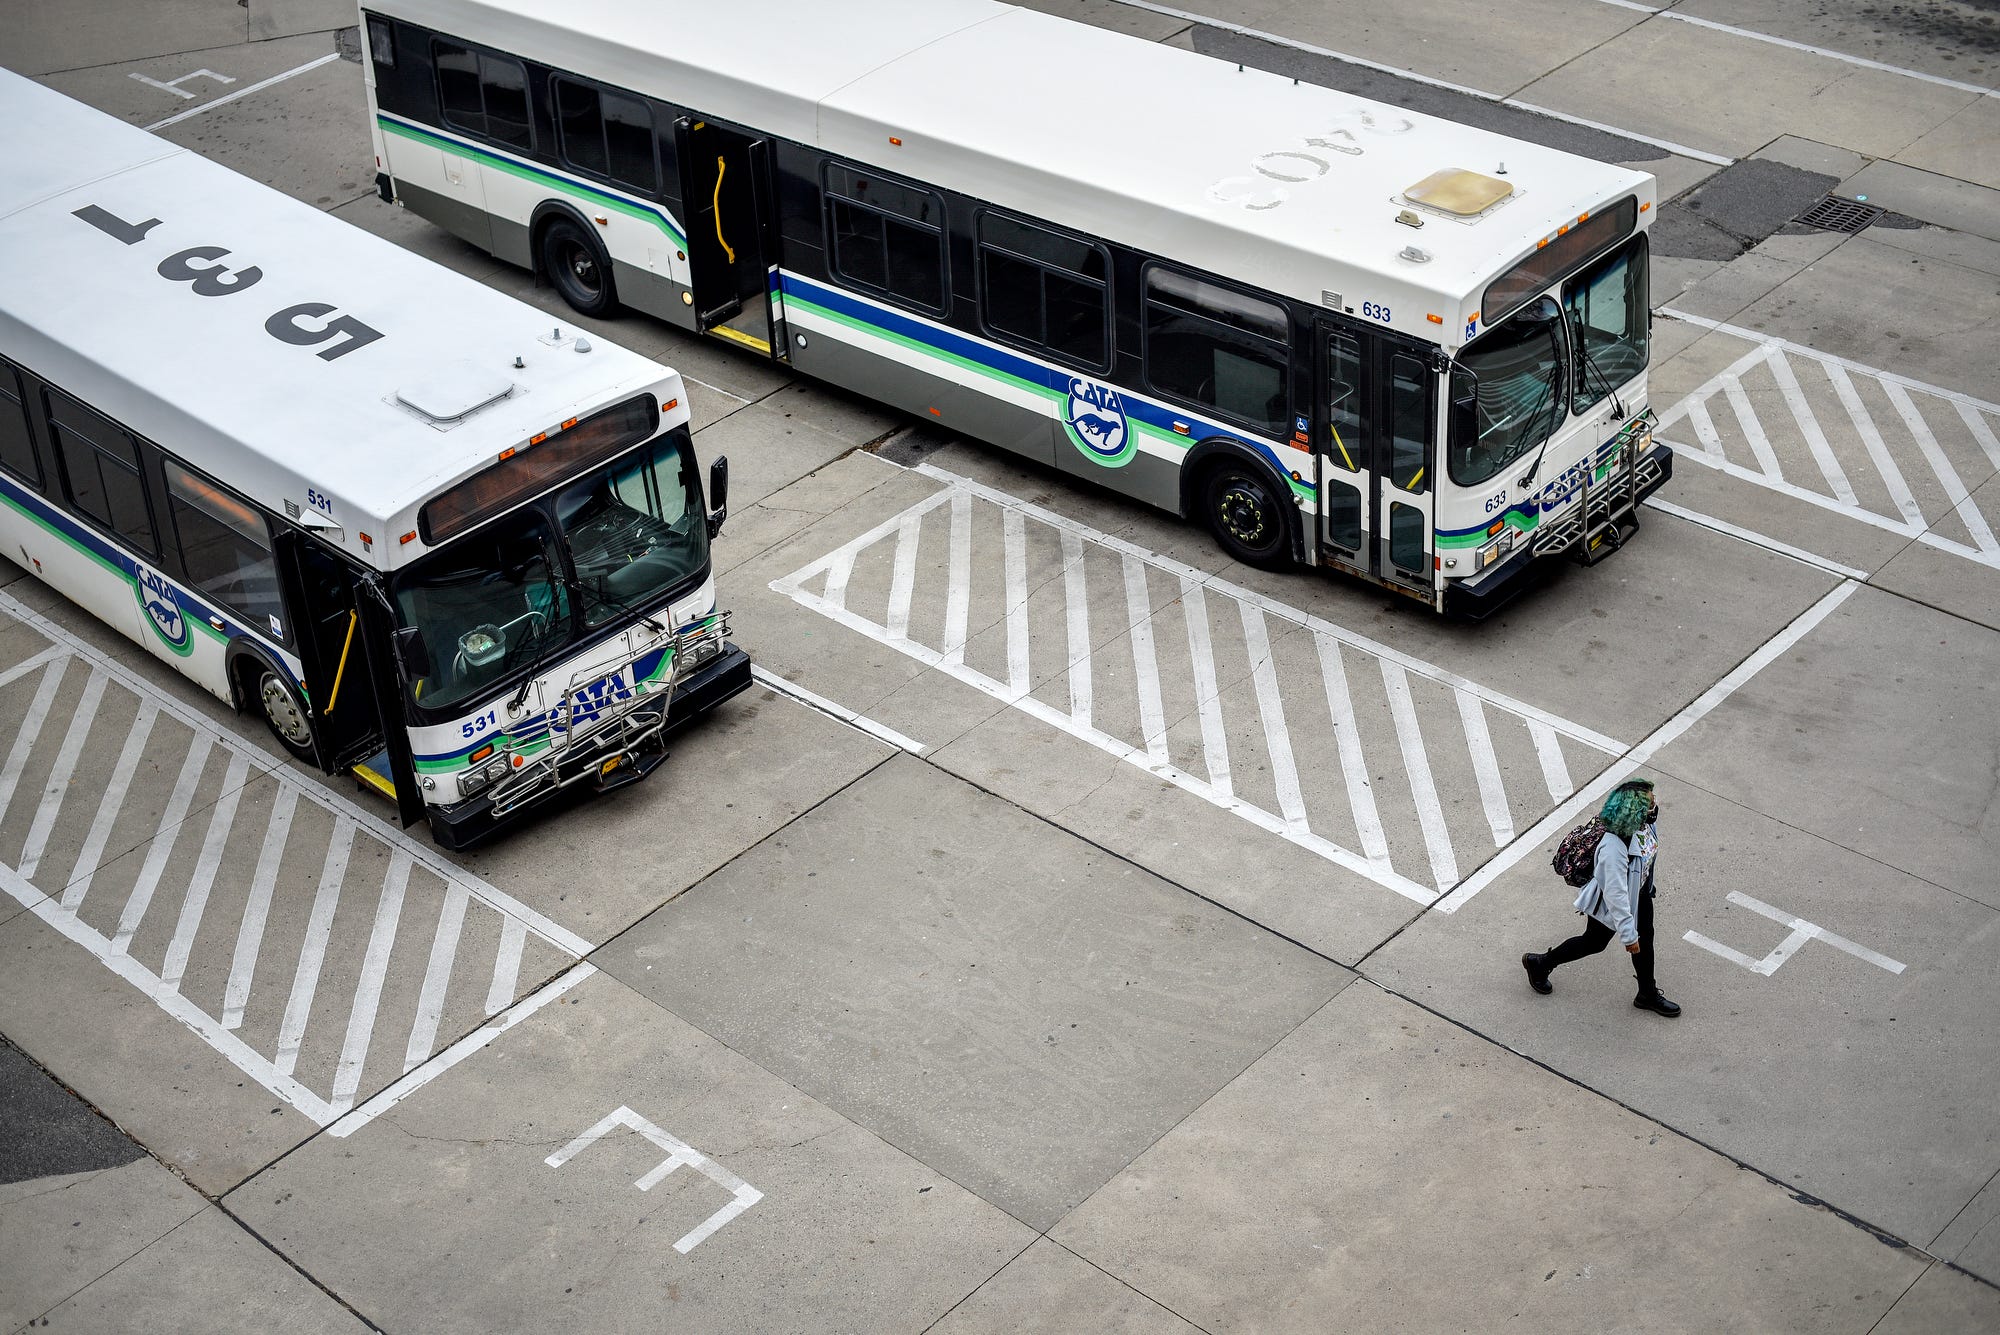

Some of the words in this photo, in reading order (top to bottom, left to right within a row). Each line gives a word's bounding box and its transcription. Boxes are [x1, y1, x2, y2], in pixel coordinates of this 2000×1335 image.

[71, 204, 385, 361] 531
[1363, 301, 1391, 323] 633
[1069, 377, 1123, 415] CATA
[308, 488, 333, 515] 531
[1485, 490, 1507, 514] 633
[135, 563, 176, 604] CATA
[550, 673, 633, 733] CATA
[462, 710, 496, 738] 531
